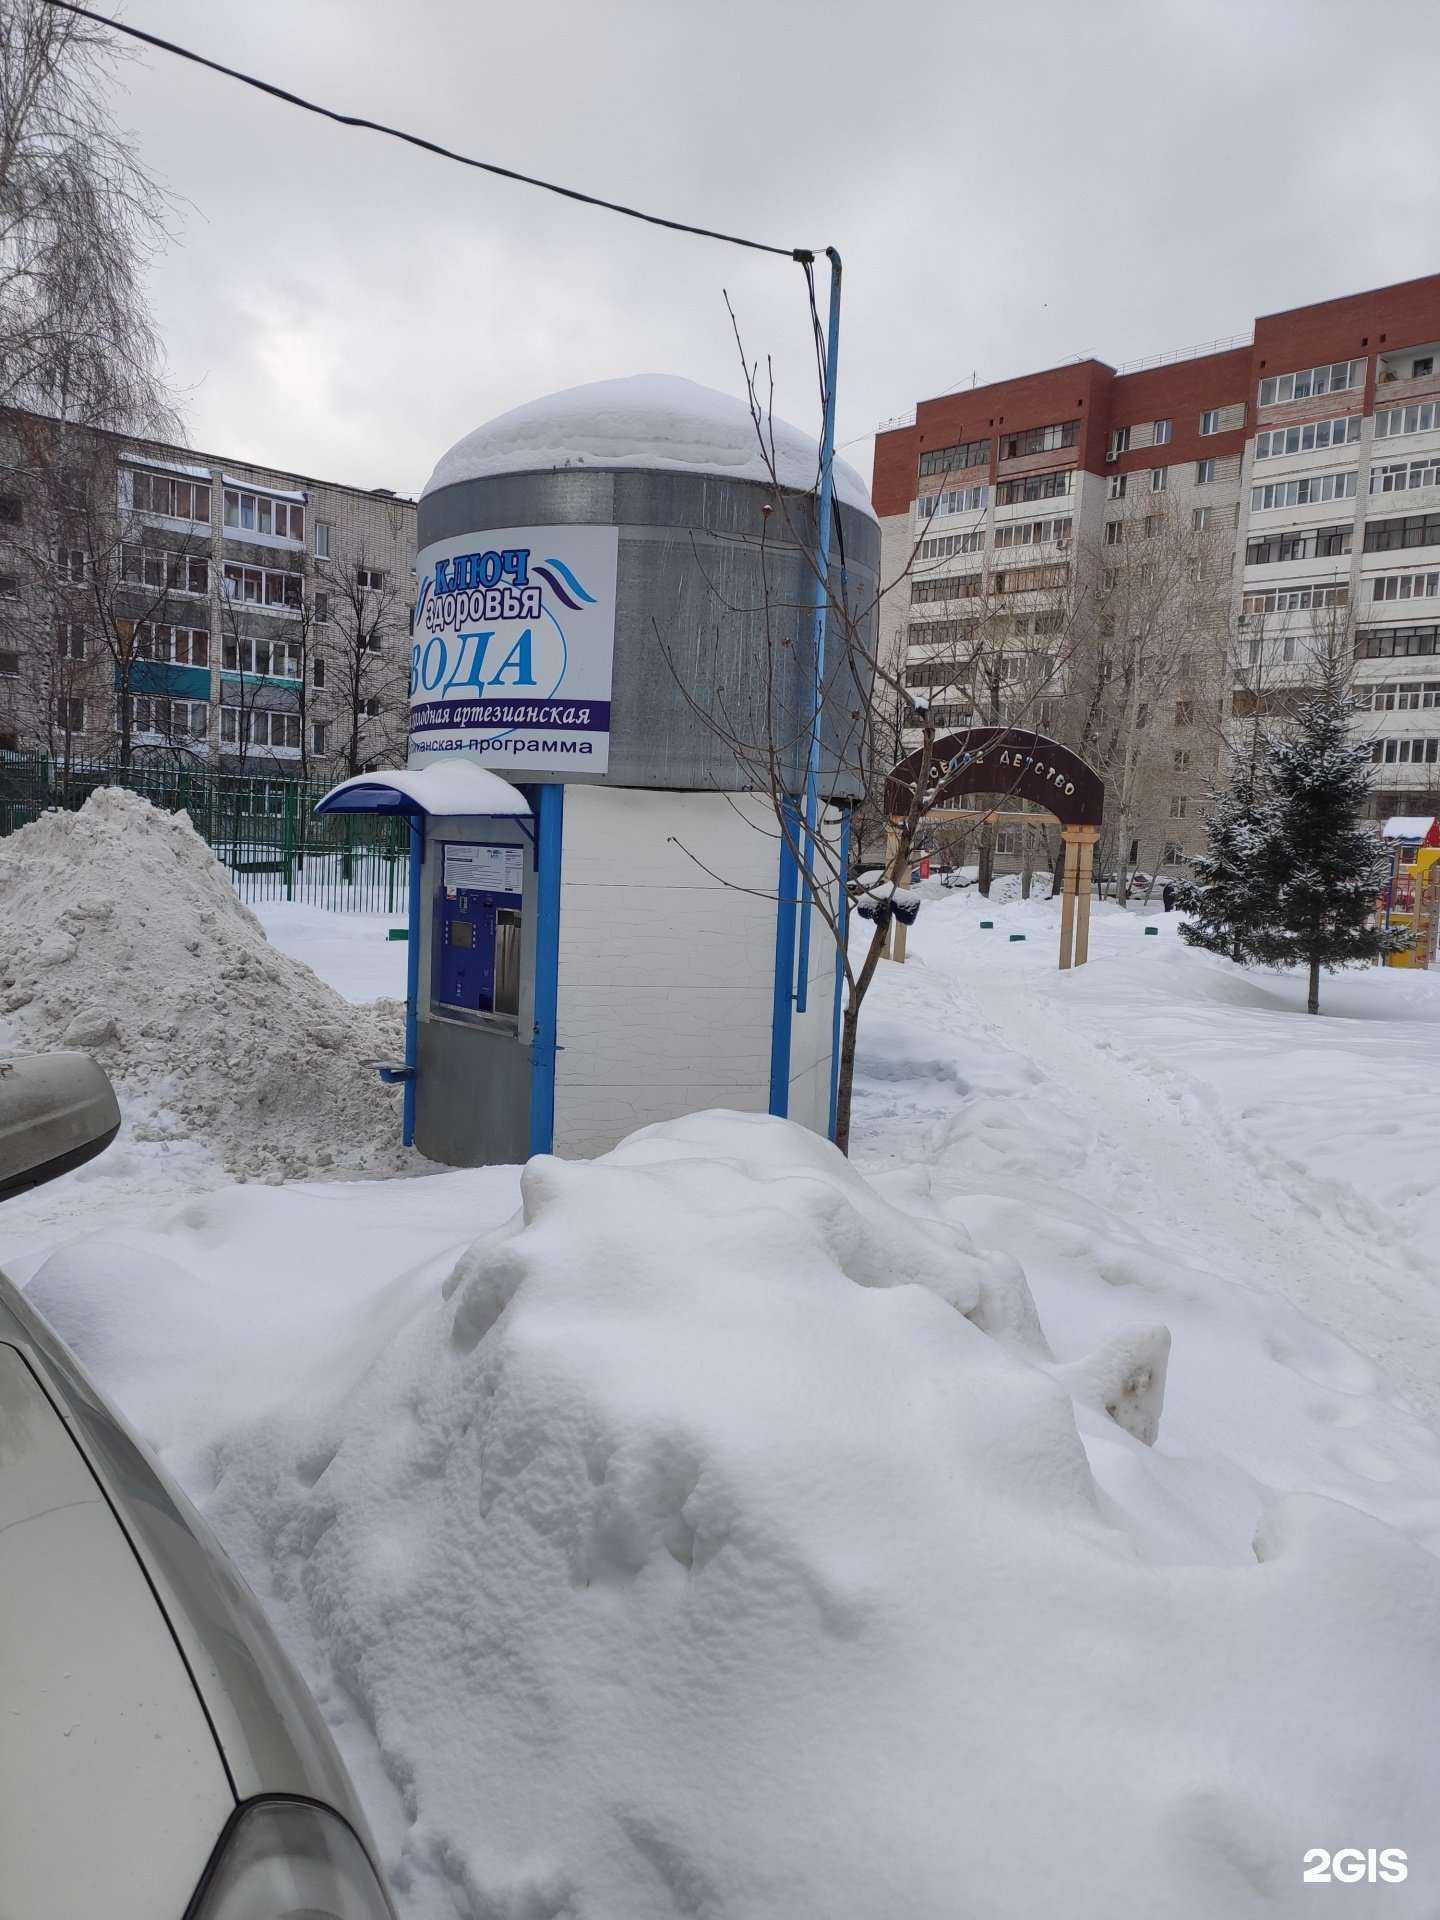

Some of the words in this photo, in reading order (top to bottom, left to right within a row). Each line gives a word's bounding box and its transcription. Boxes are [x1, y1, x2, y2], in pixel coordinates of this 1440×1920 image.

[434, 549, 530, 596] КЛЮЧ
[453, 704, 591, 728] артезианская
[469, 738, 593, 755] программа
